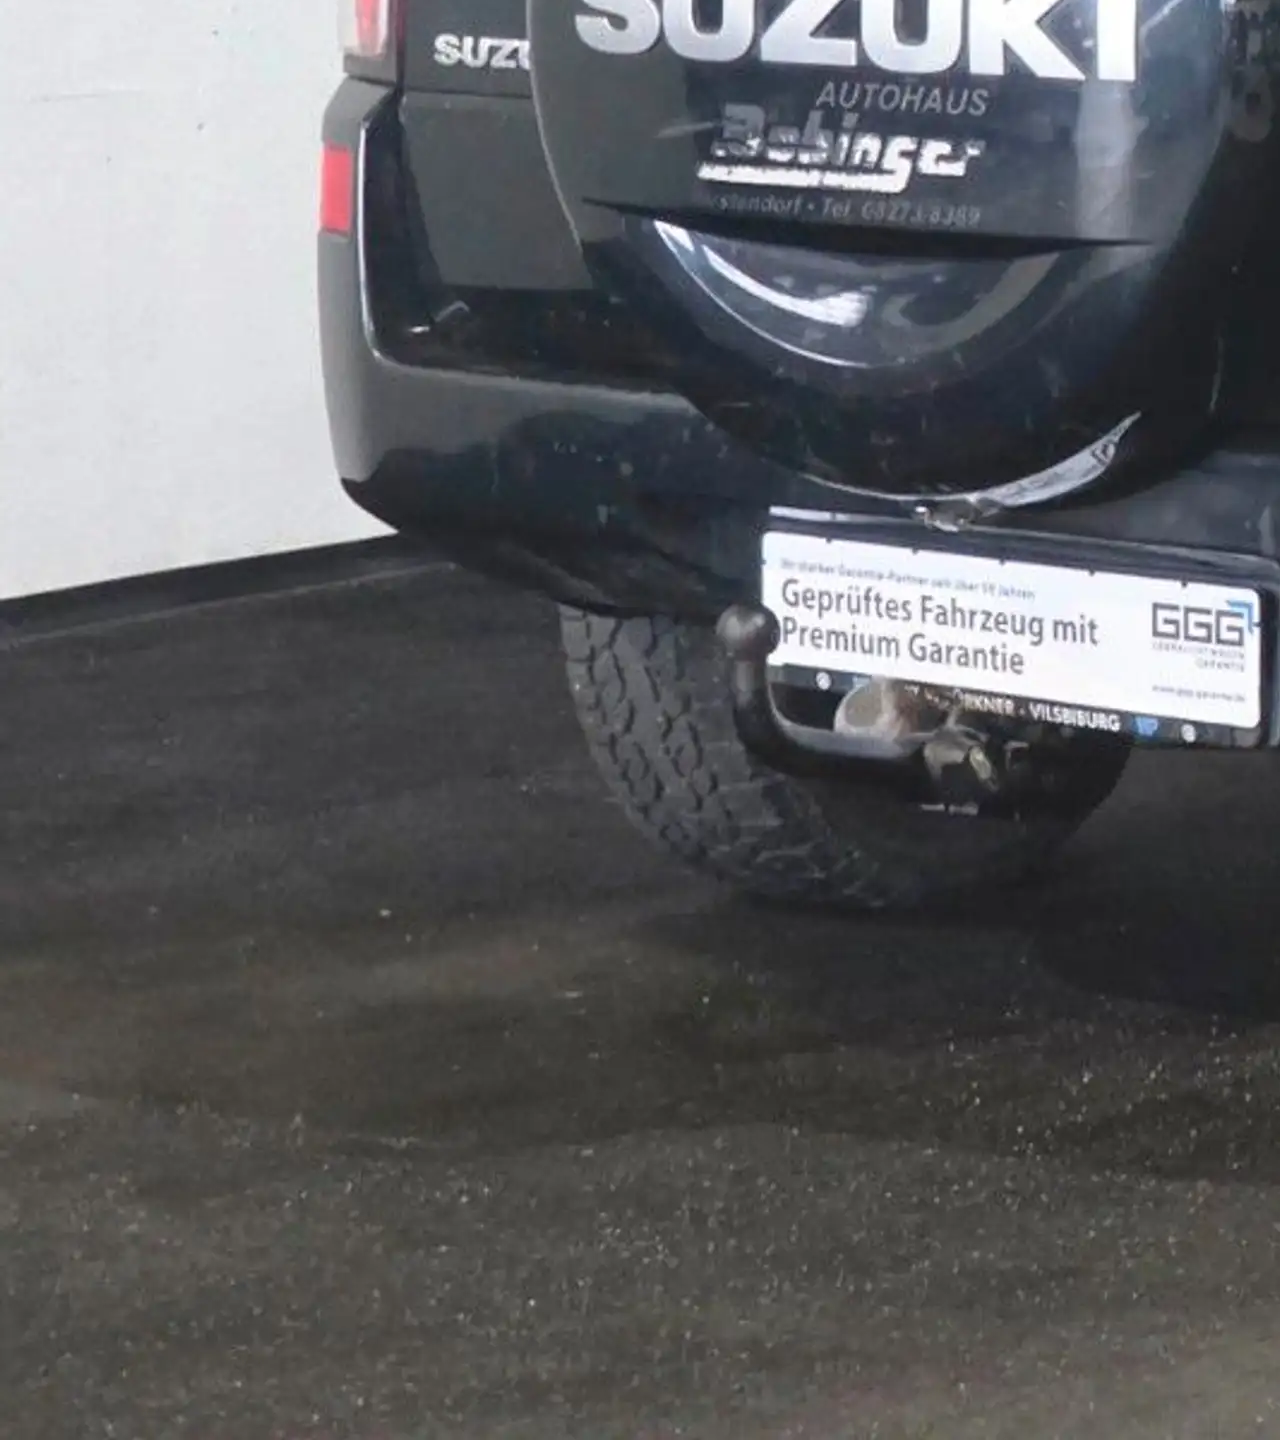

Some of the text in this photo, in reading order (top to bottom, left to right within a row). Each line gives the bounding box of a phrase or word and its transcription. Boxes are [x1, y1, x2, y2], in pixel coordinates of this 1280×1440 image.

[815, 81, 990, 116] AUTOHAUS
[782, 578, 1099, 646] Geprüftes Fahrzeug mit
[1152, 602, 1245, 647] GGG
[781, 616, 1025, 675] Premium Garantie
[1029, 703, 1122, 732] VILSBIBURG
